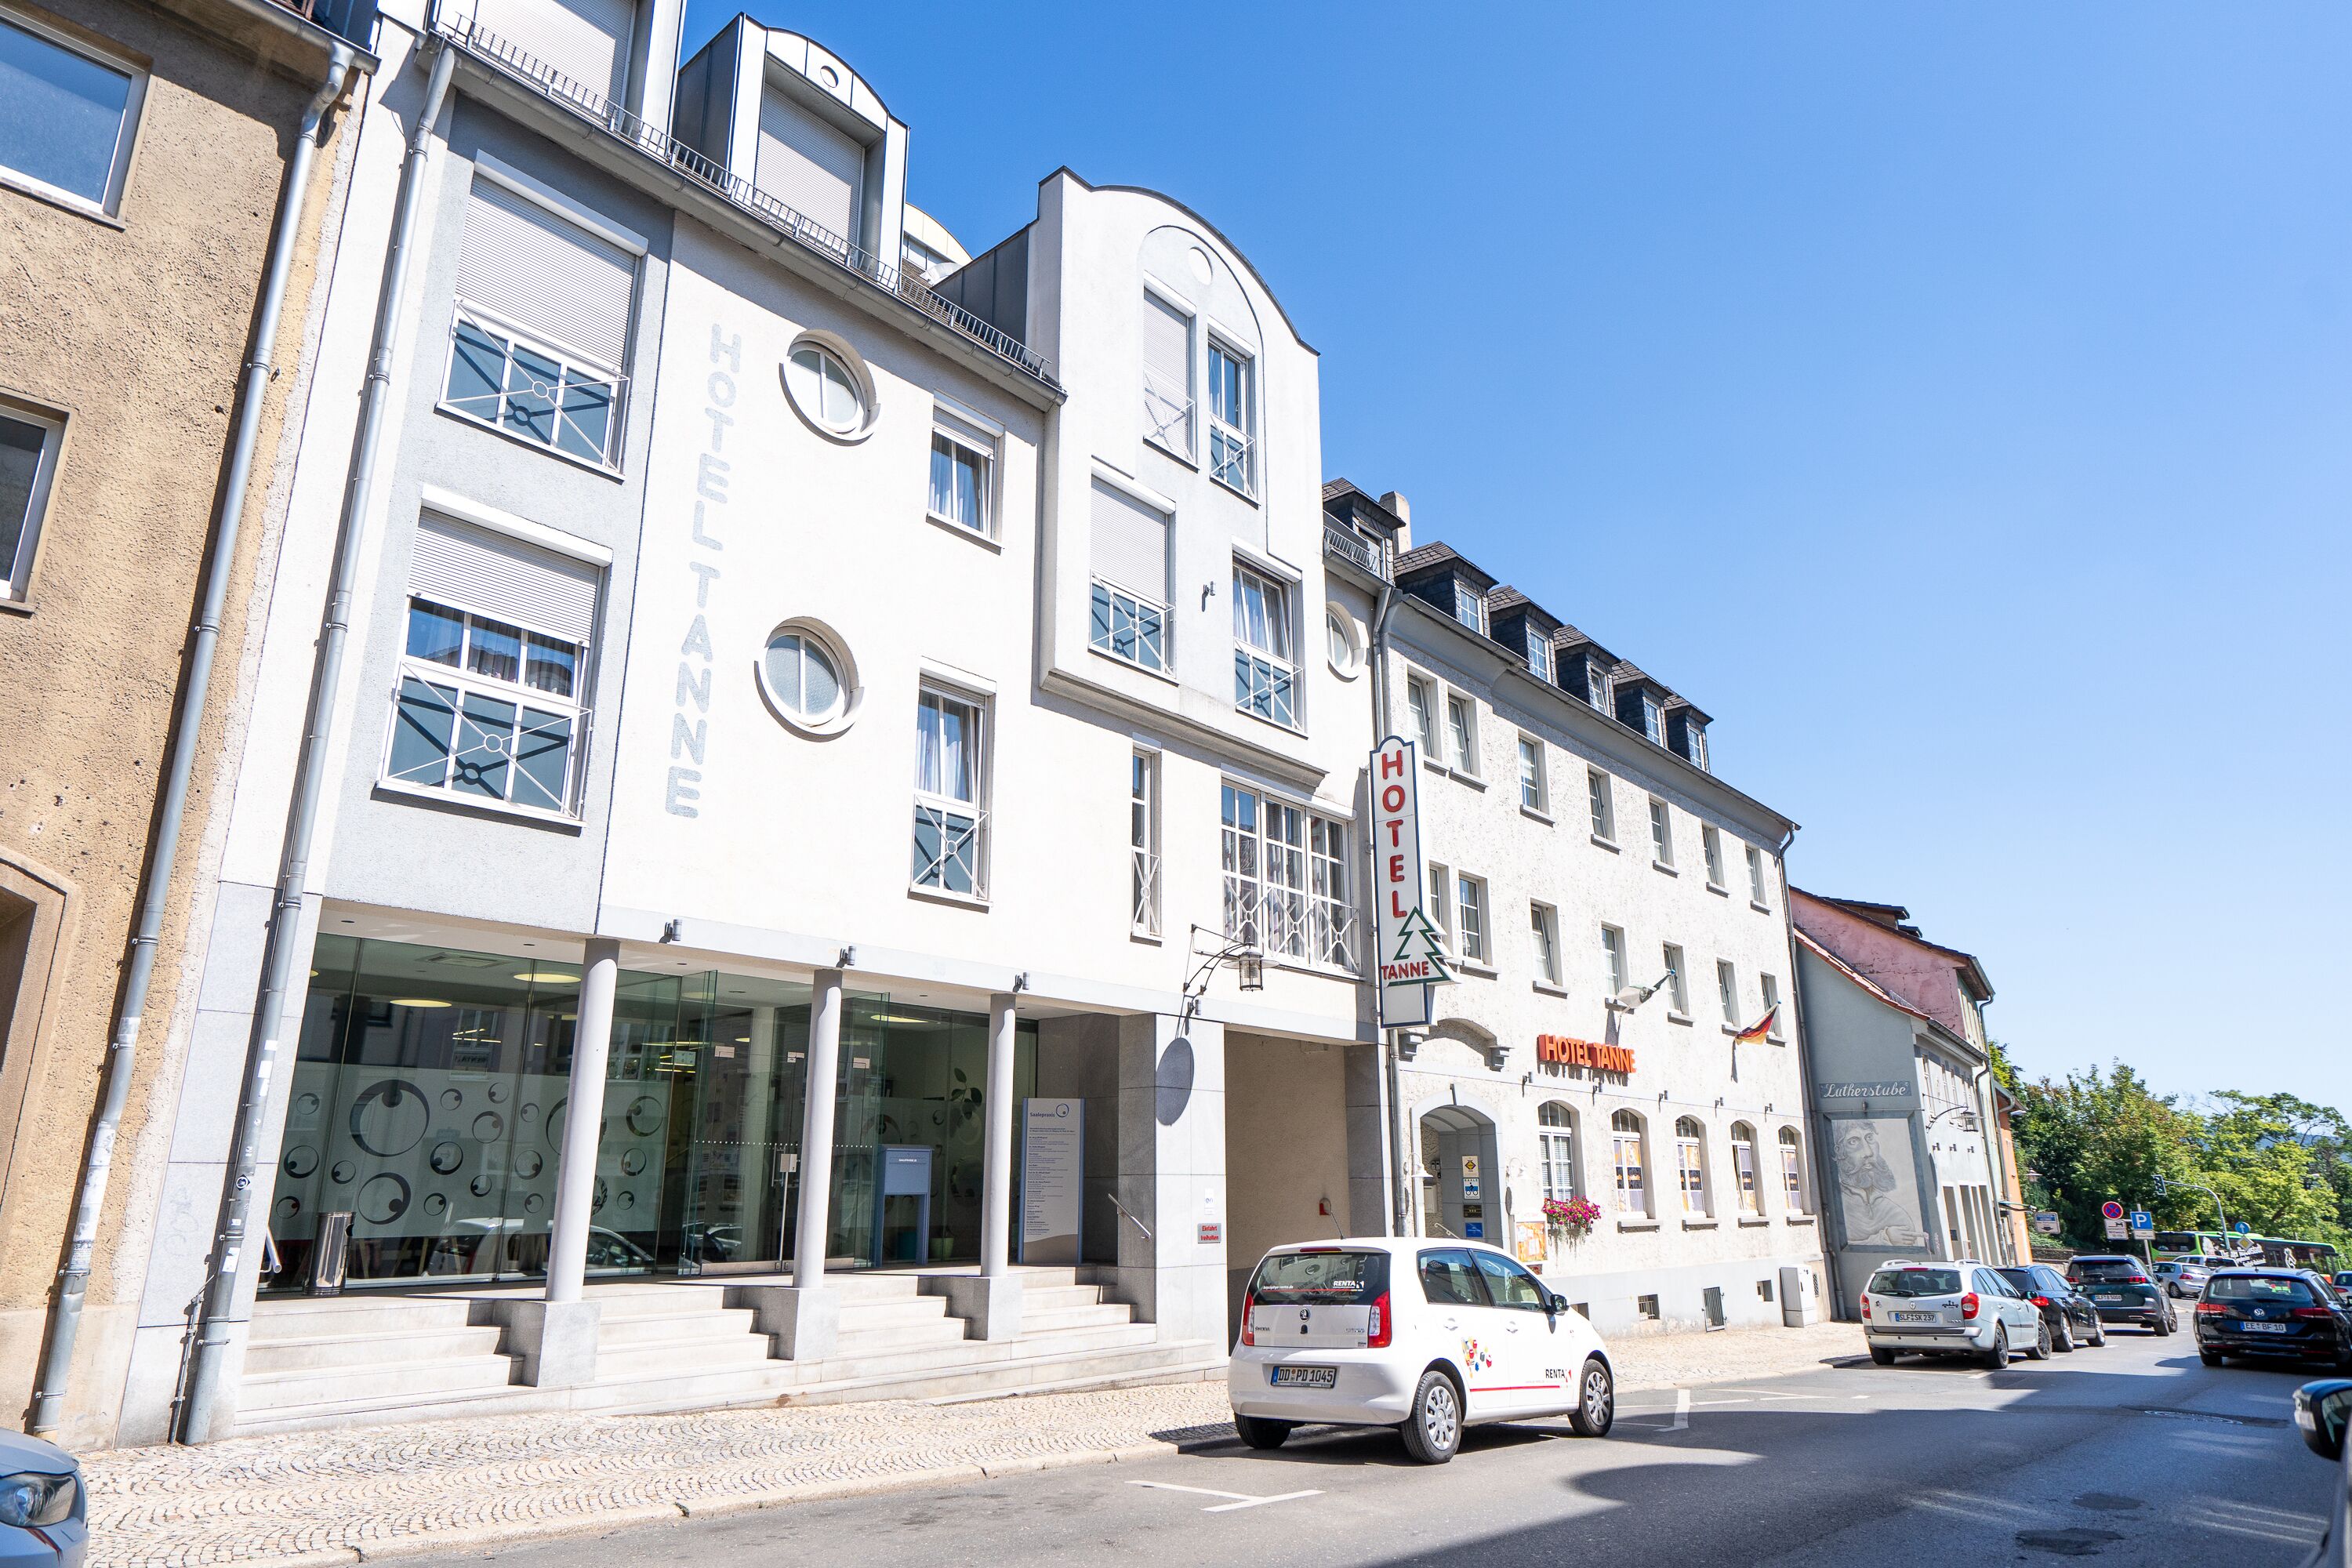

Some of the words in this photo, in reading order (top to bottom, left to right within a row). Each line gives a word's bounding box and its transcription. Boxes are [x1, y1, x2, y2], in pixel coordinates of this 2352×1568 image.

[692, 323, 741, 551] HOTEL
[666, 561, 721, 818] TANNE
[1381, 750, 1408, 918] HOTEL
[1381, 960, 1429, 980] TANNE
[1541, 1034, 1592, 1067] HOTEL
[1591, 1042, 1637, 1073] TANNE
[1824, 1082, 1907, 1098] Lutherstube
[2136, 1214, 2147, 1228] P
[1278, 1369, 1290, 1381] DD
[1296, 1369, 1308, 1381] PD
[1309, 1370, 1334, 1383] 1045
[1545, 1369, 1565, 1378] RENTA
